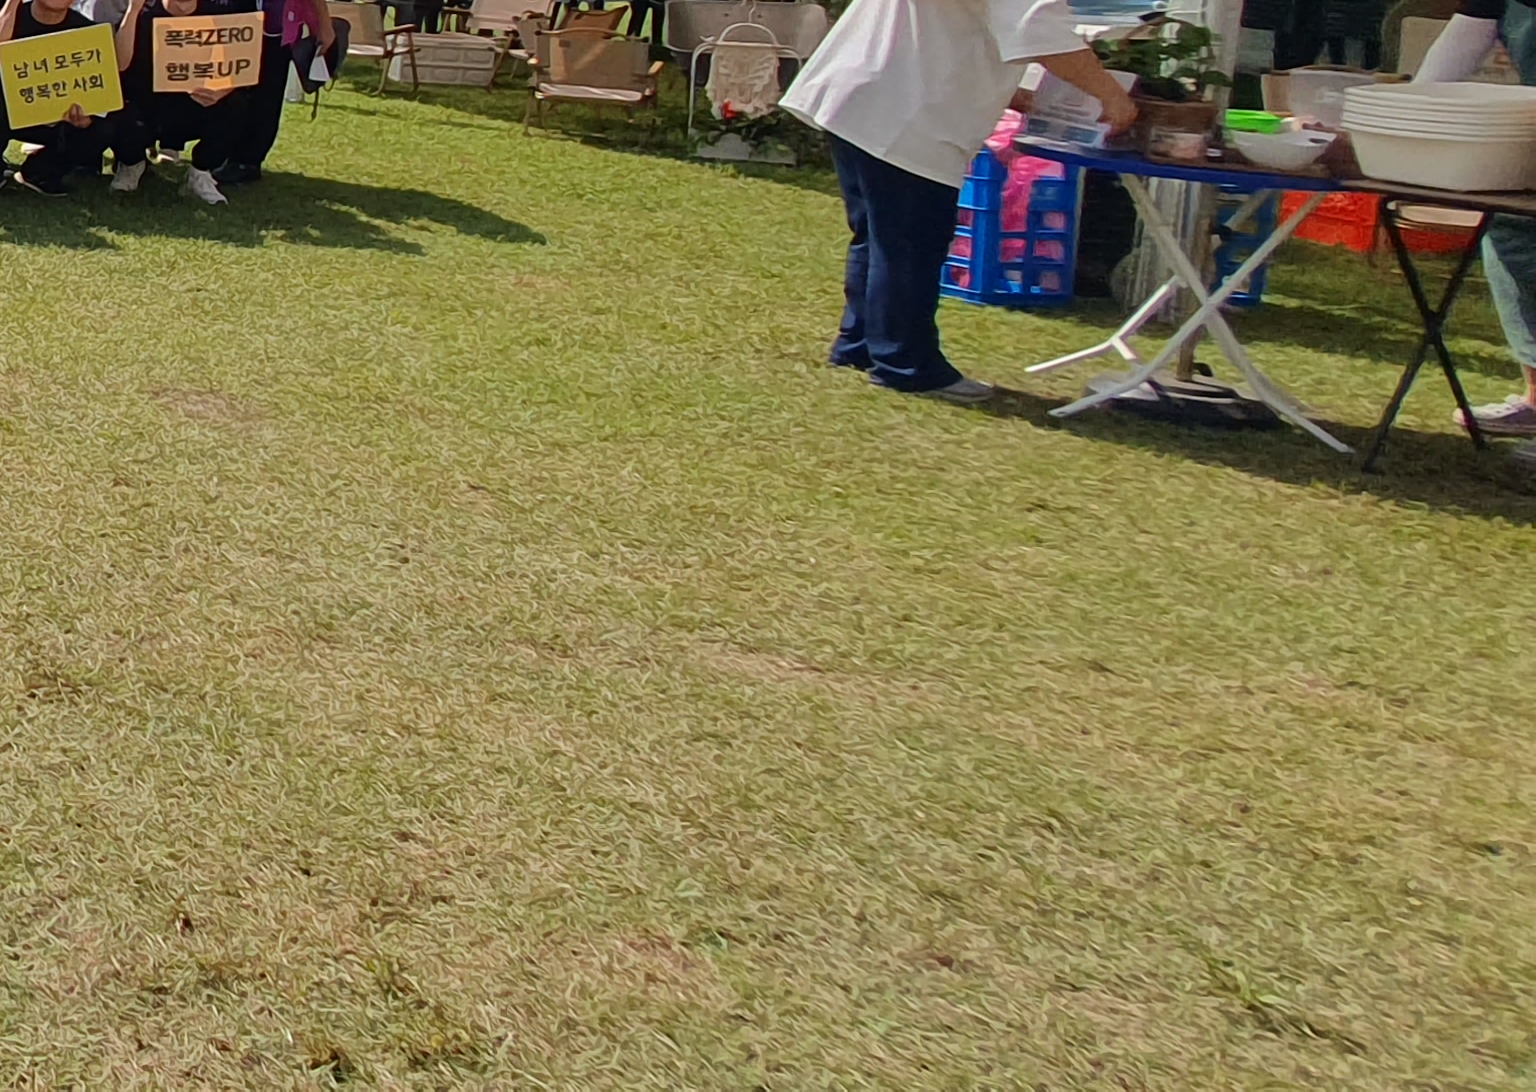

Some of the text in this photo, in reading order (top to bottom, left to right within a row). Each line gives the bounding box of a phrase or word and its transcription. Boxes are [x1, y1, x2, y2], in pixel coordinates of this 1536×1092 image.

[164, 25, 254, 48] 폭력ZERO
[54, 48, 102, 70] 모두가
[165, 58, 251, 82] 행복UP
[18, 73, 105, 105] 행복한 사회
